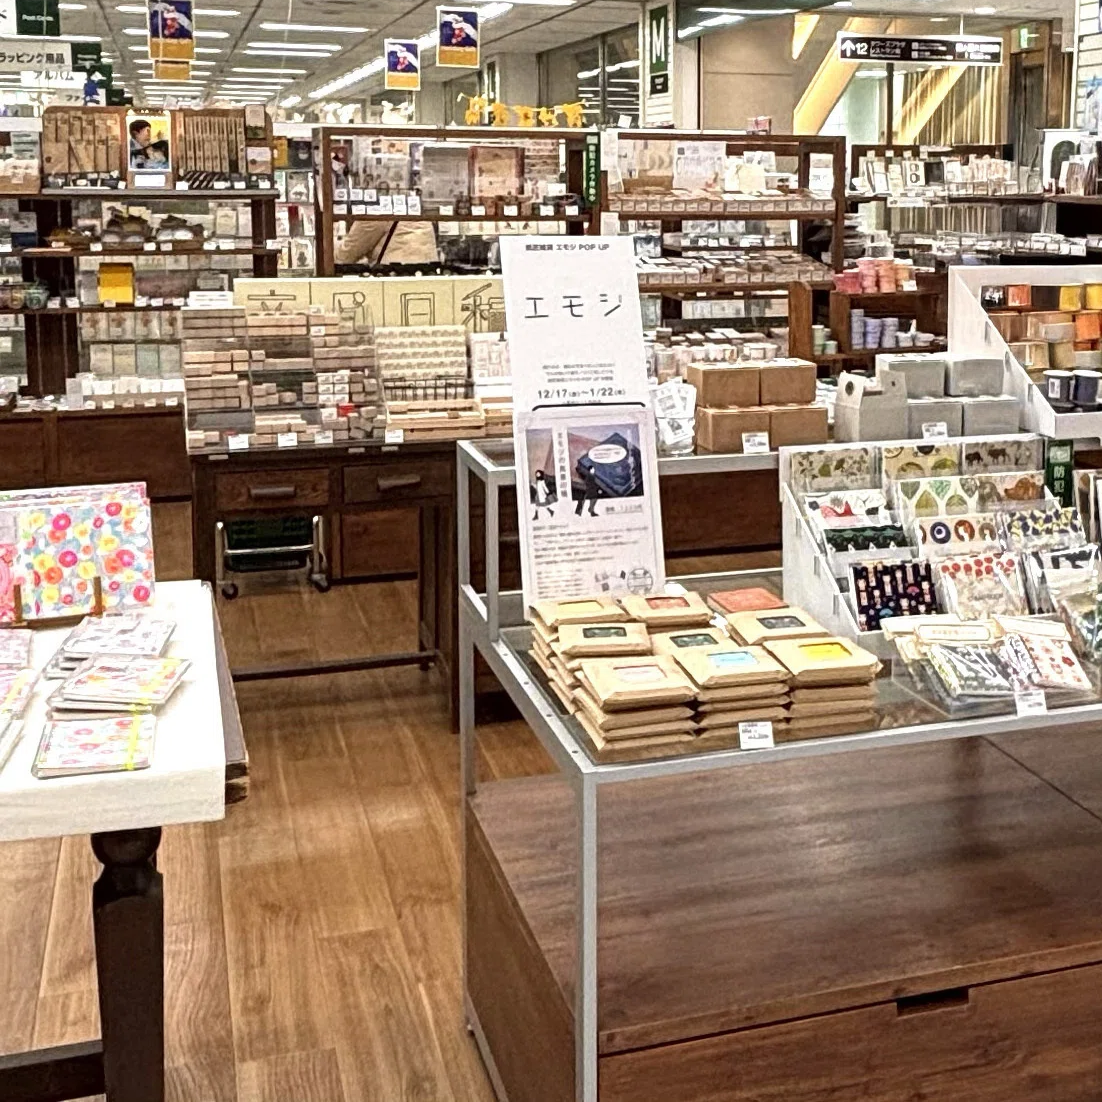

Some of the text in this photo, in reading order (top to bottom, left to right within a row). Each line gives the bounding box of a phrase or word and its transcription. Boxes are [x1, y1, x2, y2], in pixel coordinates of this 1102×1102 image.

[652, 17, 665, 64] M
[855, 43, 868, 55] 12
[579, 243, 596, 251] POP
[524, 293, 623, 319] エモジ
